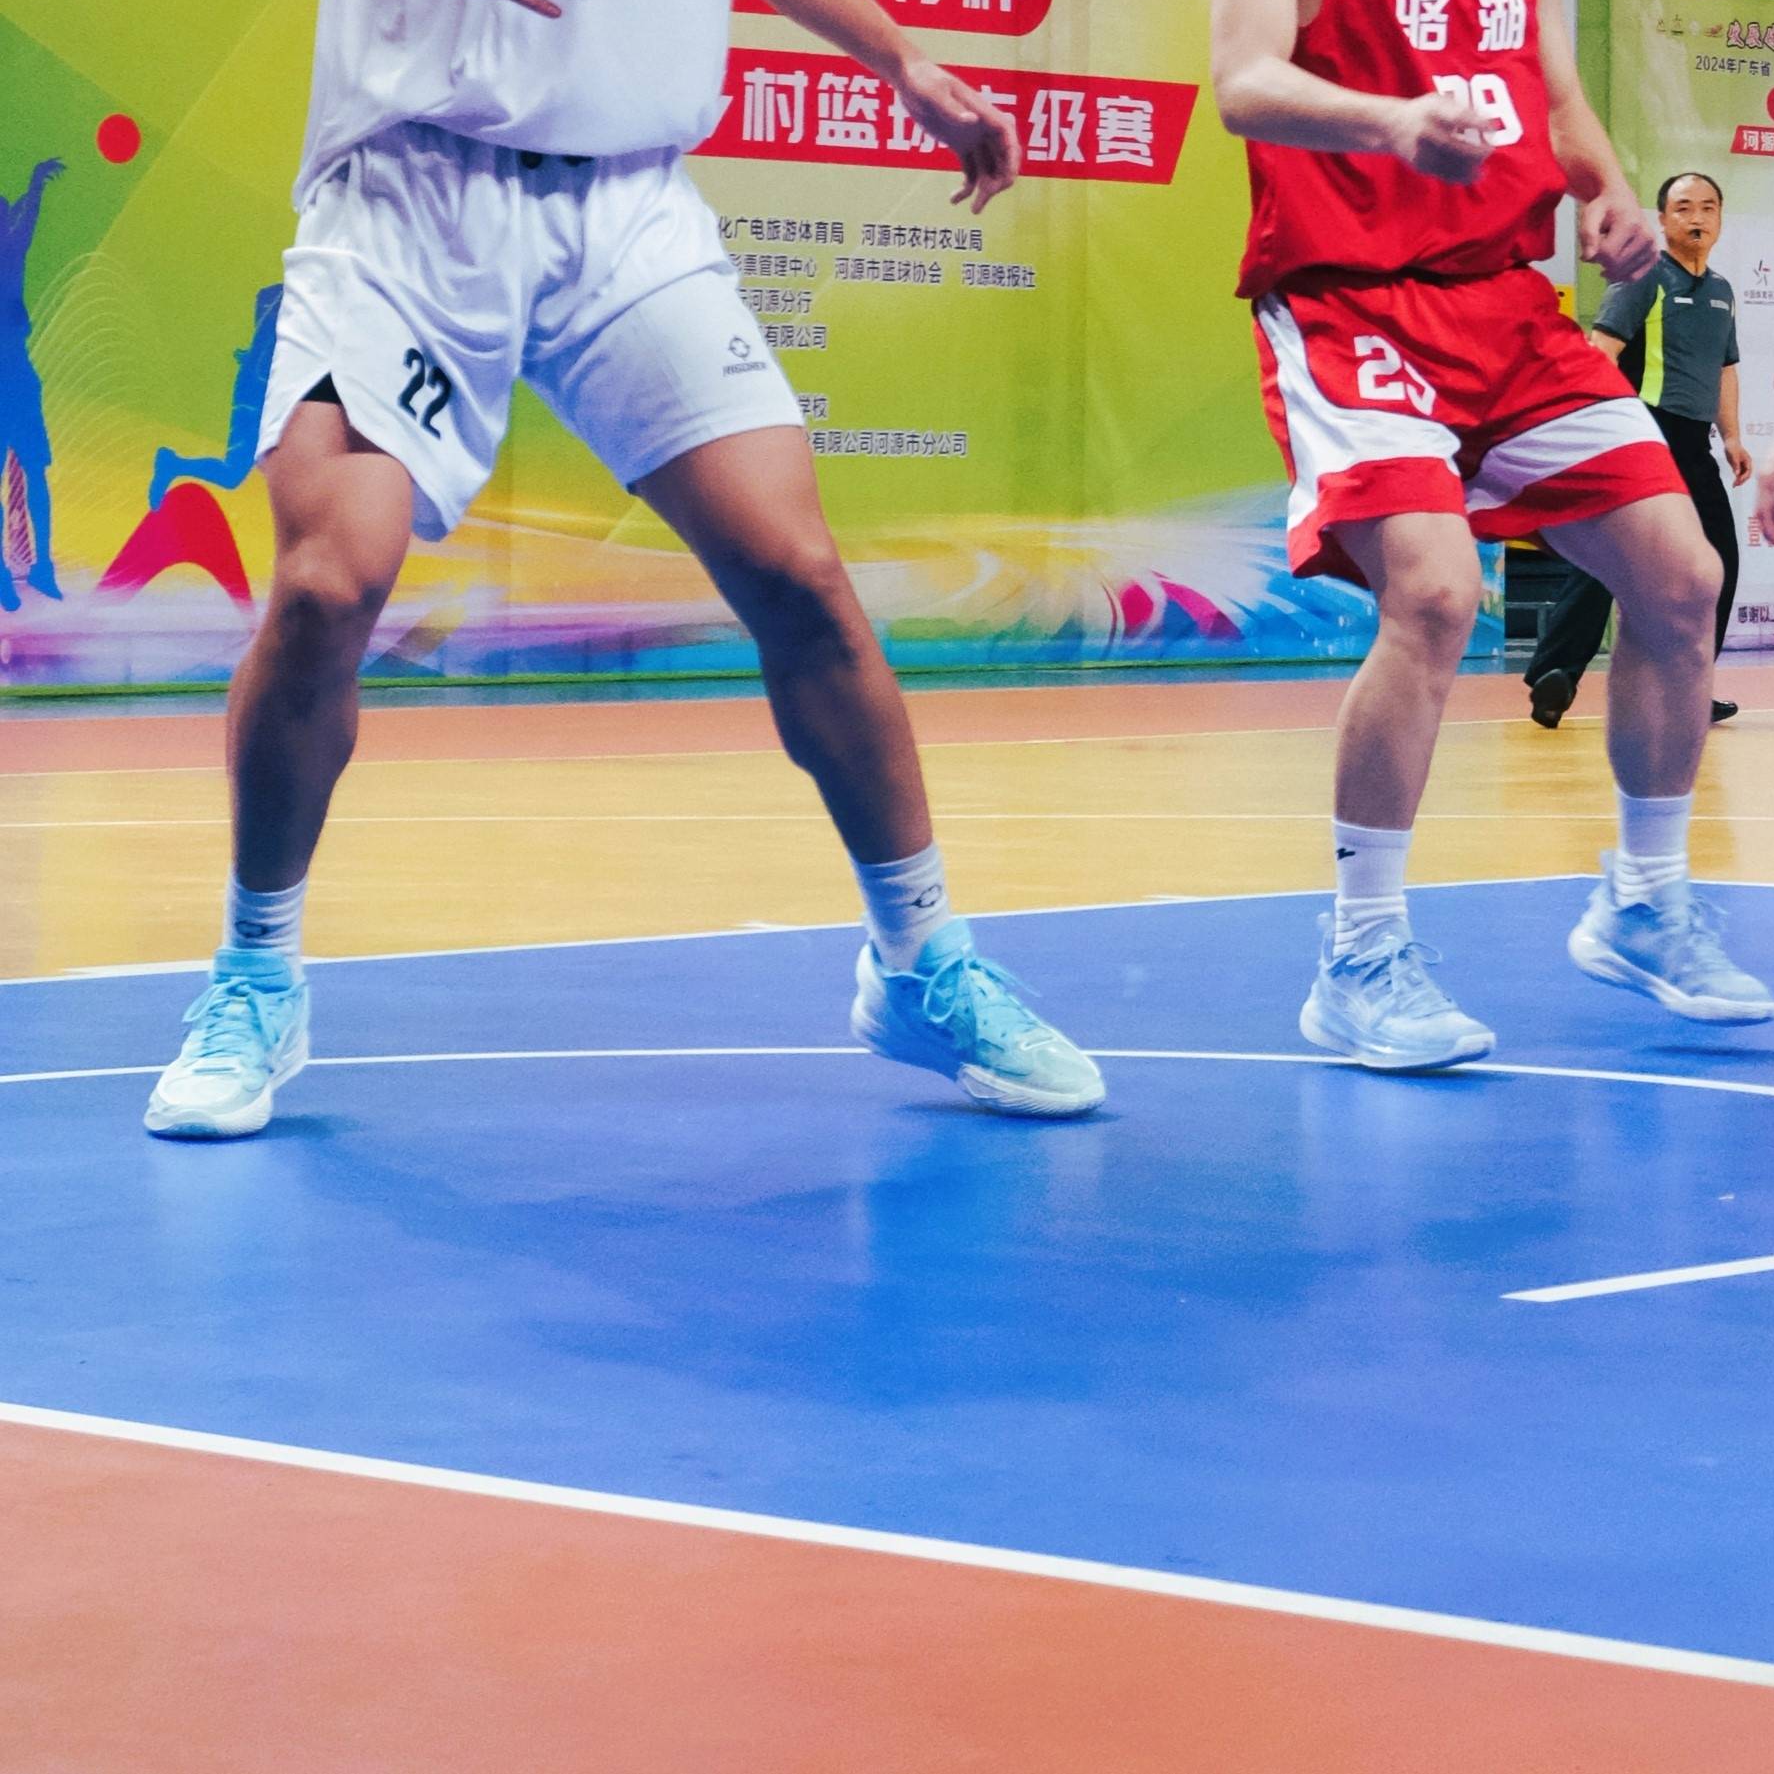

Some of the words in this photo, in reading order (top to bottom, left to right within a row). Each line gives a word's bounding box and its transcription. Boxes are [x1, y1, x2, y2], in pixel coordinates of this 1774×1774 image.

[861, 223, 983, 252] 河源市农村农业局
[834, 257, 943, 285] 河源市篮球协会
[961, 262, 1037, 289] 河源晚报社
[762, 325, 828, 350] 有限公司
[397, 346, 453, 442] 22
[807, 432, 968, 457] 有限公司河源市分公司
